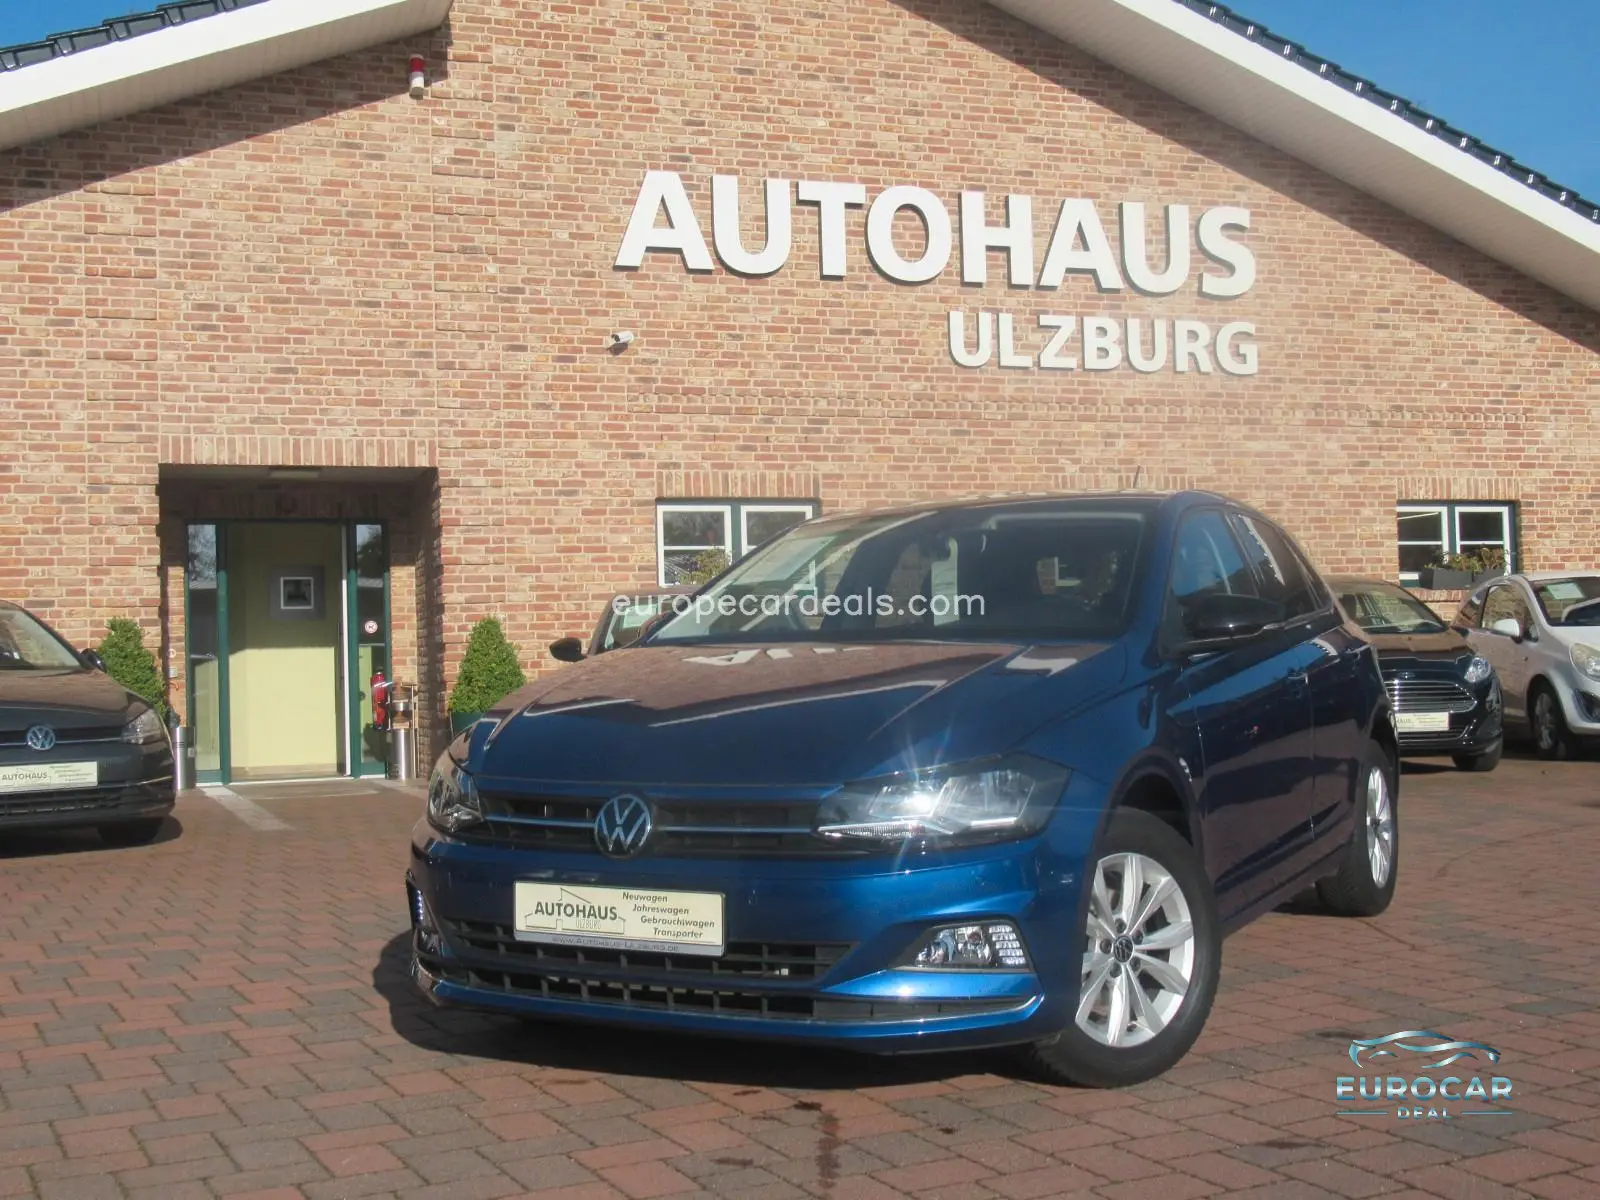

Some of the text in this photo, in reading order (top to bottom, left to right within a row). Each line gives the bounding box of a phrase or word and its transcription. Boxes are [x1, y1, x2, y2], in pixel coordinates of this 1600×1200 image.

[614, 169, 1257, 297] AUTOHAUS
[947, 310, 1259, 376] ULZBURG
[2, 772, 48, 781] AUTOHAUS
[622, 891, 668, 904] Neuwagen
[534, 901, 618, 921] AUTOHAUS
[632, 903, 690, 916] Jahreswagen
[652, 927, 704, 939] Transporter
